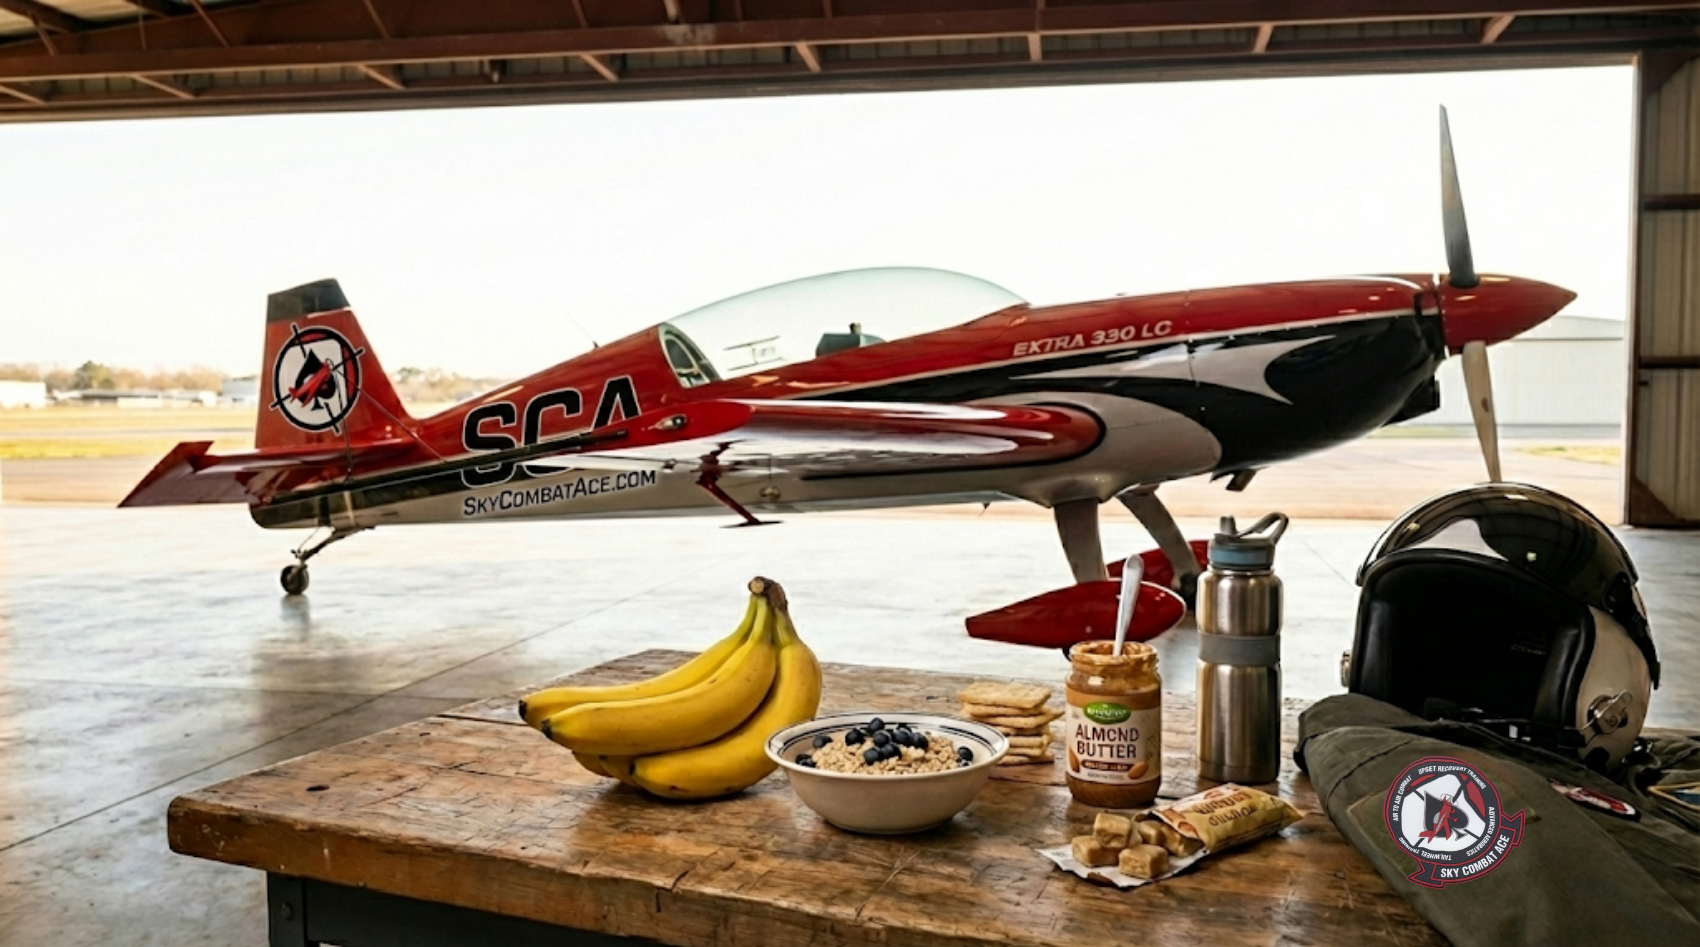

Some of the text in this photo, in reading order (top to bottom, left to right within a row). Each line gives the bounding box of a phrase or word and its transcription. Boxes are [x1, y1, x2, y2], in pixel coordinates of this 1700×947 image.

[1012, 320, 1173, 356] EXTRA 330 LC
[462, 375, 641, 488] SCA
[1077, 741, 1137, 759] BUTTER
[1397, 774, 1412, 795] COMBAT
[1418, 765, 1436, 775] UPSET
[1467, 769, 1487, 790] TRAINING
[1392, 804, 1399, 812] TO
[1394, 794, 1402, 805] AIR
[1466, 806, 1496, 857] ADVANCED AEROBATICS
[1421, 850, 1452, 861] TAILWHEEL
[1440, 834, 1510, 878] SKY COMBAT ACE
